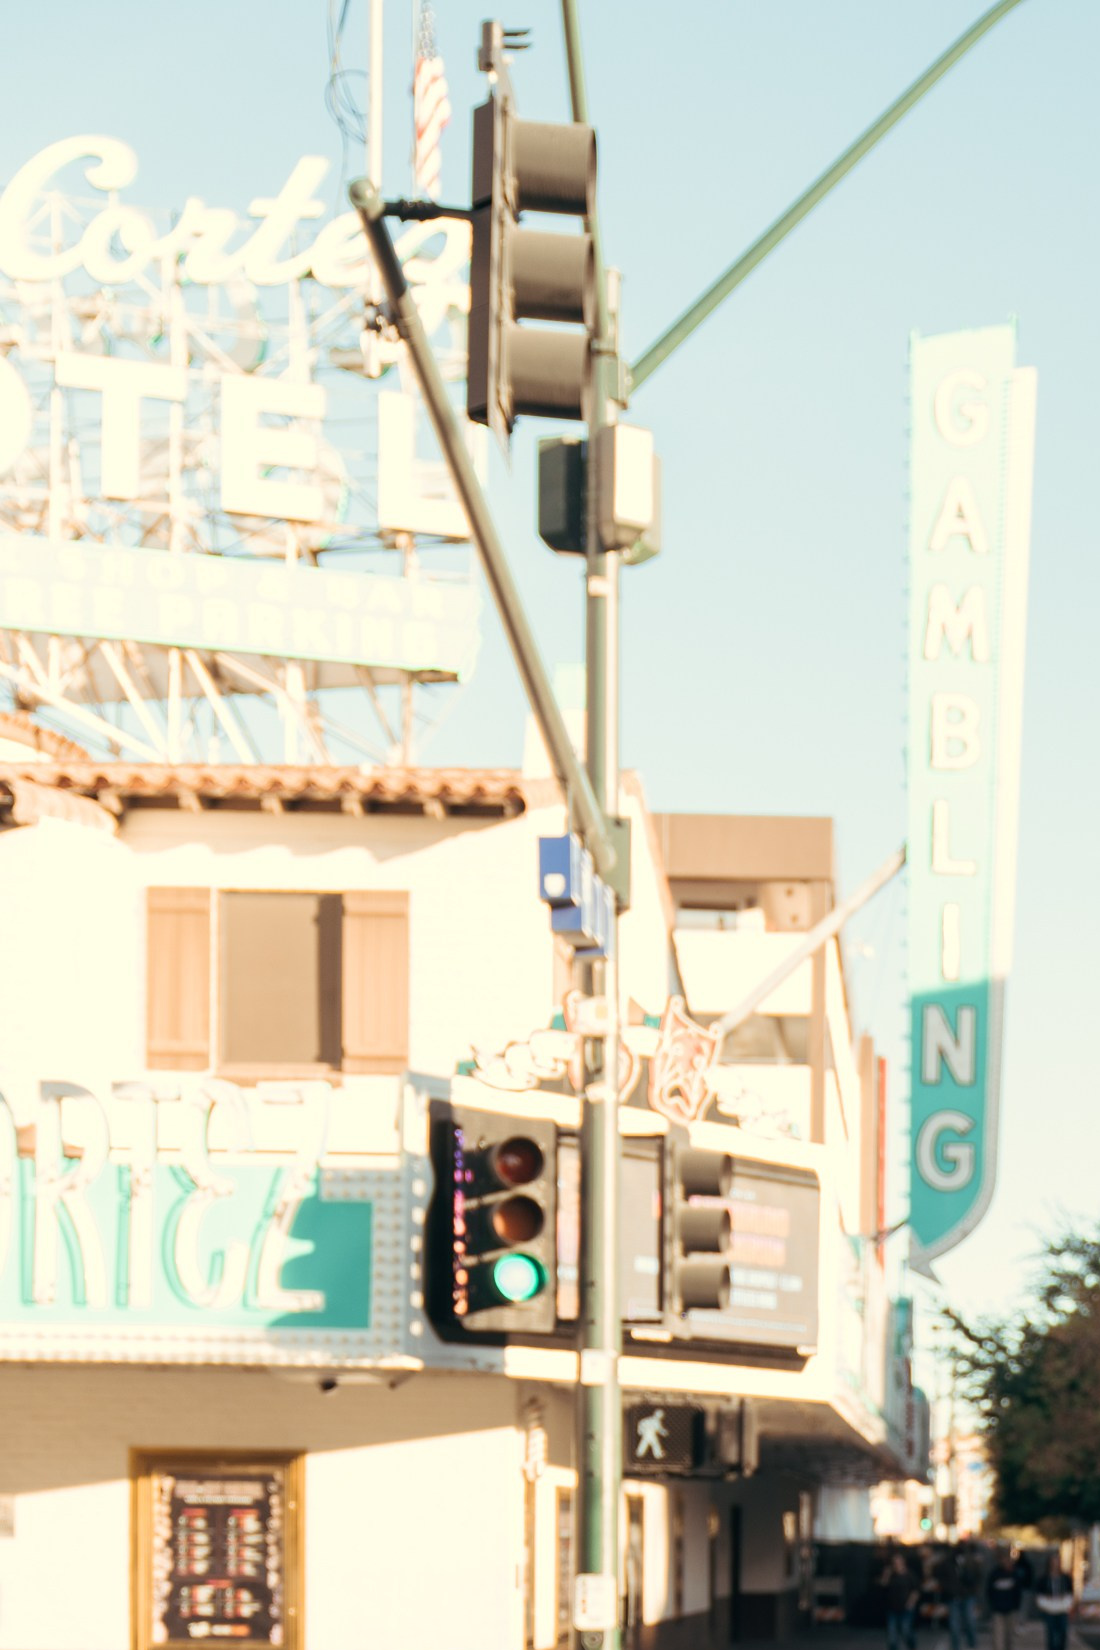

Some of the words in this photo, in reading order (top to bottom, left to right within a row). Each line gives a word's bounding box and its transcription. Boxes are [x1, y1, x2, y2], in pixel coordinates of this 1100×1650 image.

[0, 352, 472, 538] TEL
[158, 592, 440, 663] PARKING
[914, 372, 991, 1193] GAMBLING
[0, 1077, 331, 1310] RTEZ
